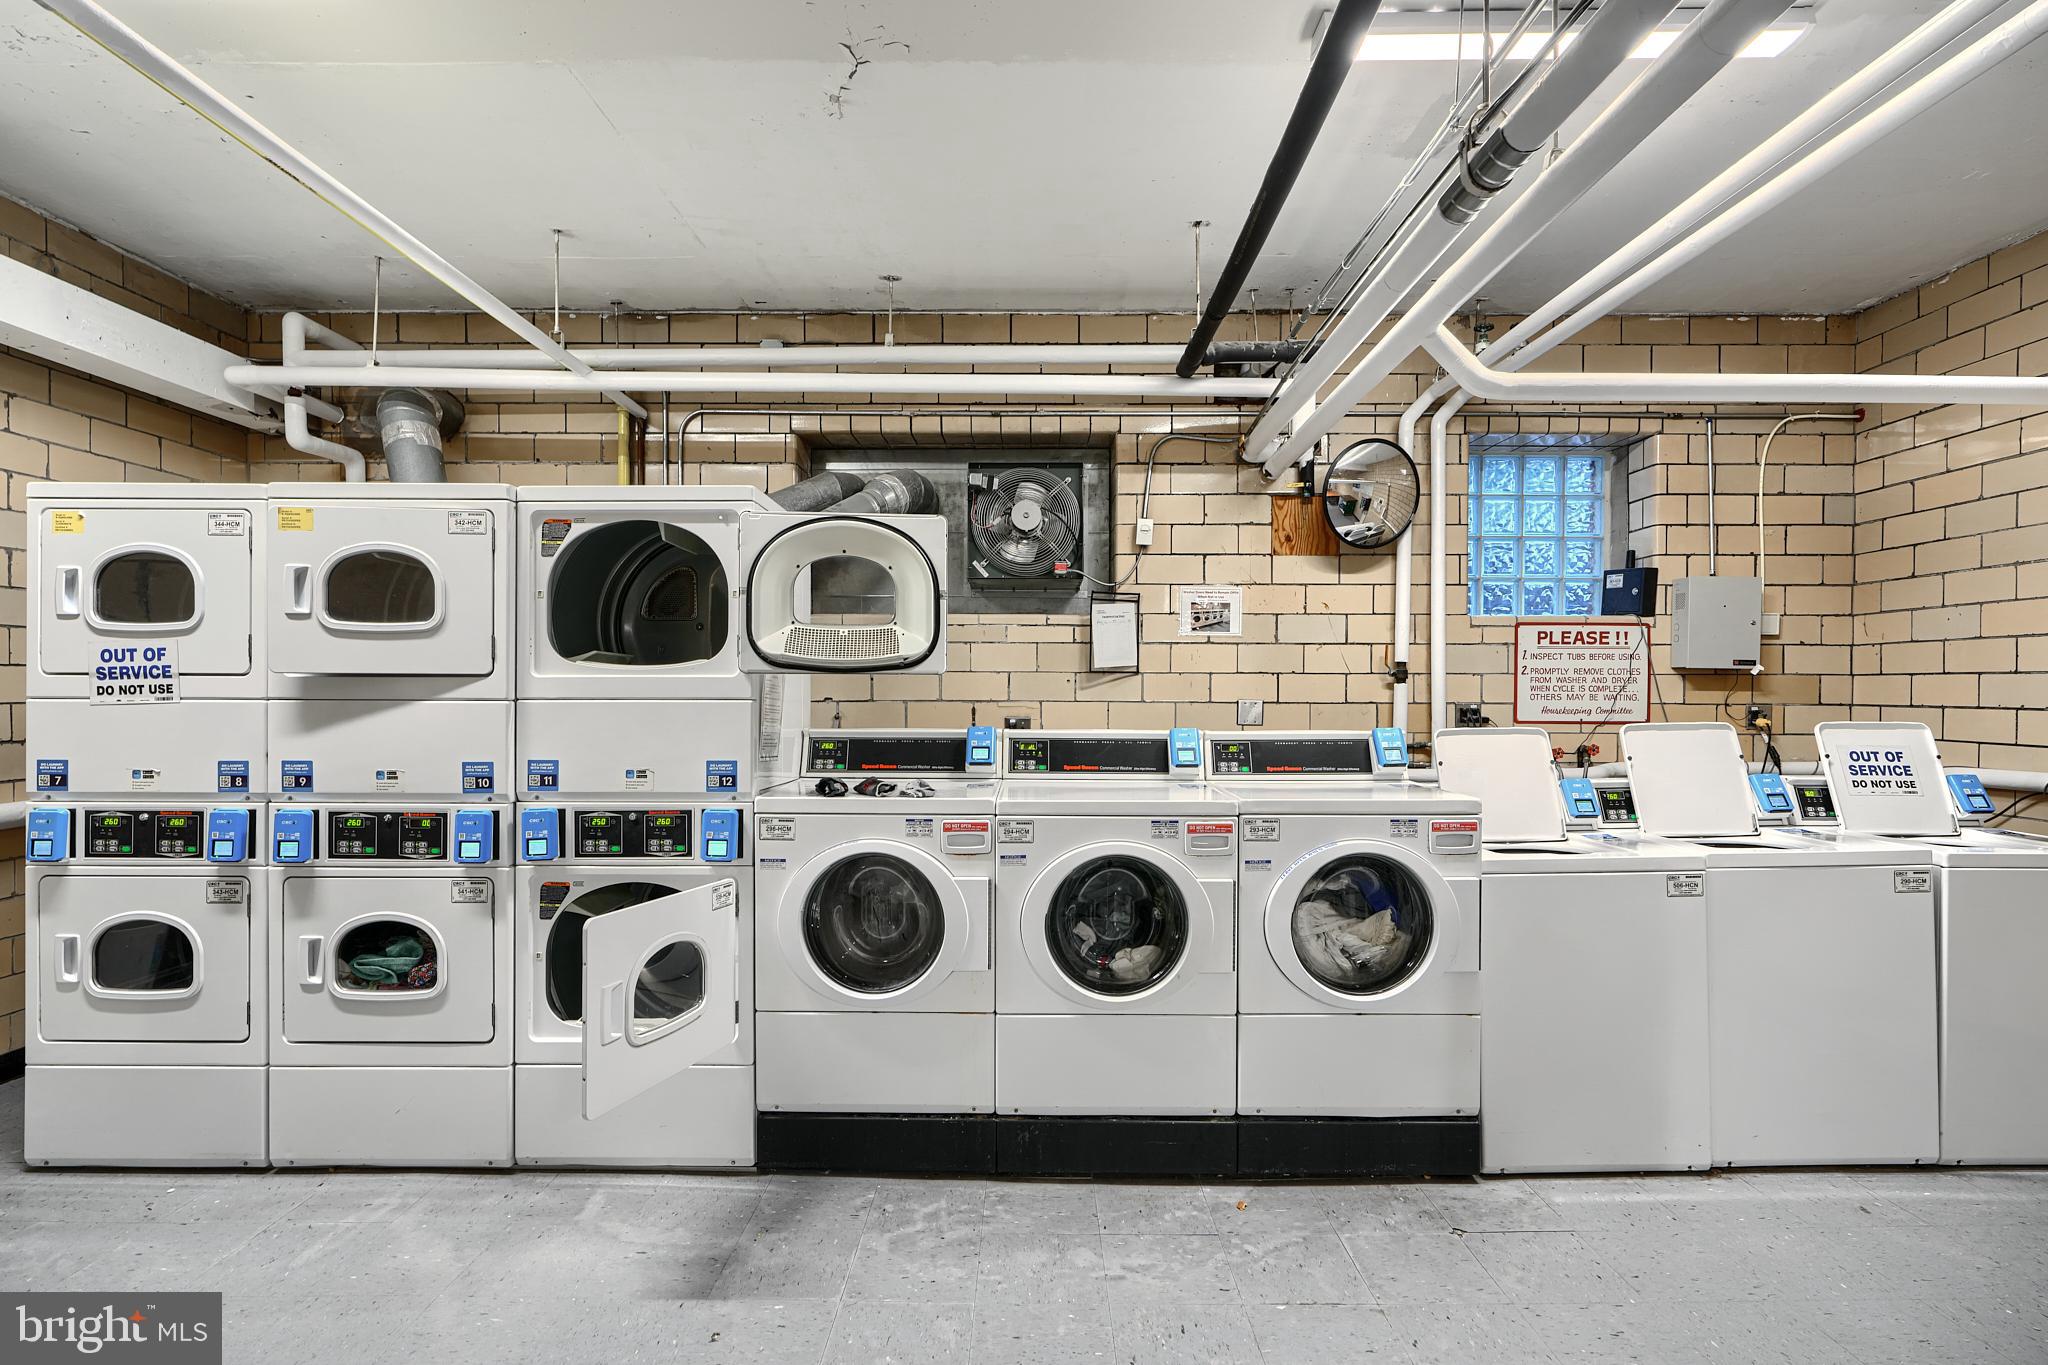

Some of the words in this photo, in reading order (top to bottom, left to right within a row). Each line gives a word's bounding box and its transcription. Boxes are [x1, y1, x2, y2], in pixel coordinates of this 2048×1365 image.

[1537, 631, 1610, 645] PLEASE
[1615, 631, 1629, 645] !!
[100, 648, 138, 663] OUT
[143, 647, 167, 662] OF
[1522, 650, 1528, 660] 1.
[1530, 653, 1563, 661] INSPECT
[1567, 653, 1586, 661] TUBS
[1589, 653, 1615, 661] BEFORE
[1618, 653, 1642, 661] USING.
[95, 665, 172, 681] SERVICE
[1521, 666, 1529, 675] 2.
[97, 685, 115, 696] DO
[118, 685, 145, 696] NOT
[148, 684, 174, 695] USE
[1541, 706, 1592, 716] Housekeeping
[1595, 706, 1633, 715] Committee
[1849, 751, 1880, 762] OUT
[1884, 751, 1904, 763] OF
[1849, 764, 1913, 777] SERVICE
[54, 776, 62, 785] 7
[235, 776, 242, 786] 8
[299, 777, 307, 786] 9
[477, 778, 490, 787] 10
[543, 776, 553, 785] 11
[721, 777, 733, 786] 12
[1852, 780, 1868, 788] DO
[1870, 780, 1892, 789] NOT
[1896, 780, 1917, 789] USE
